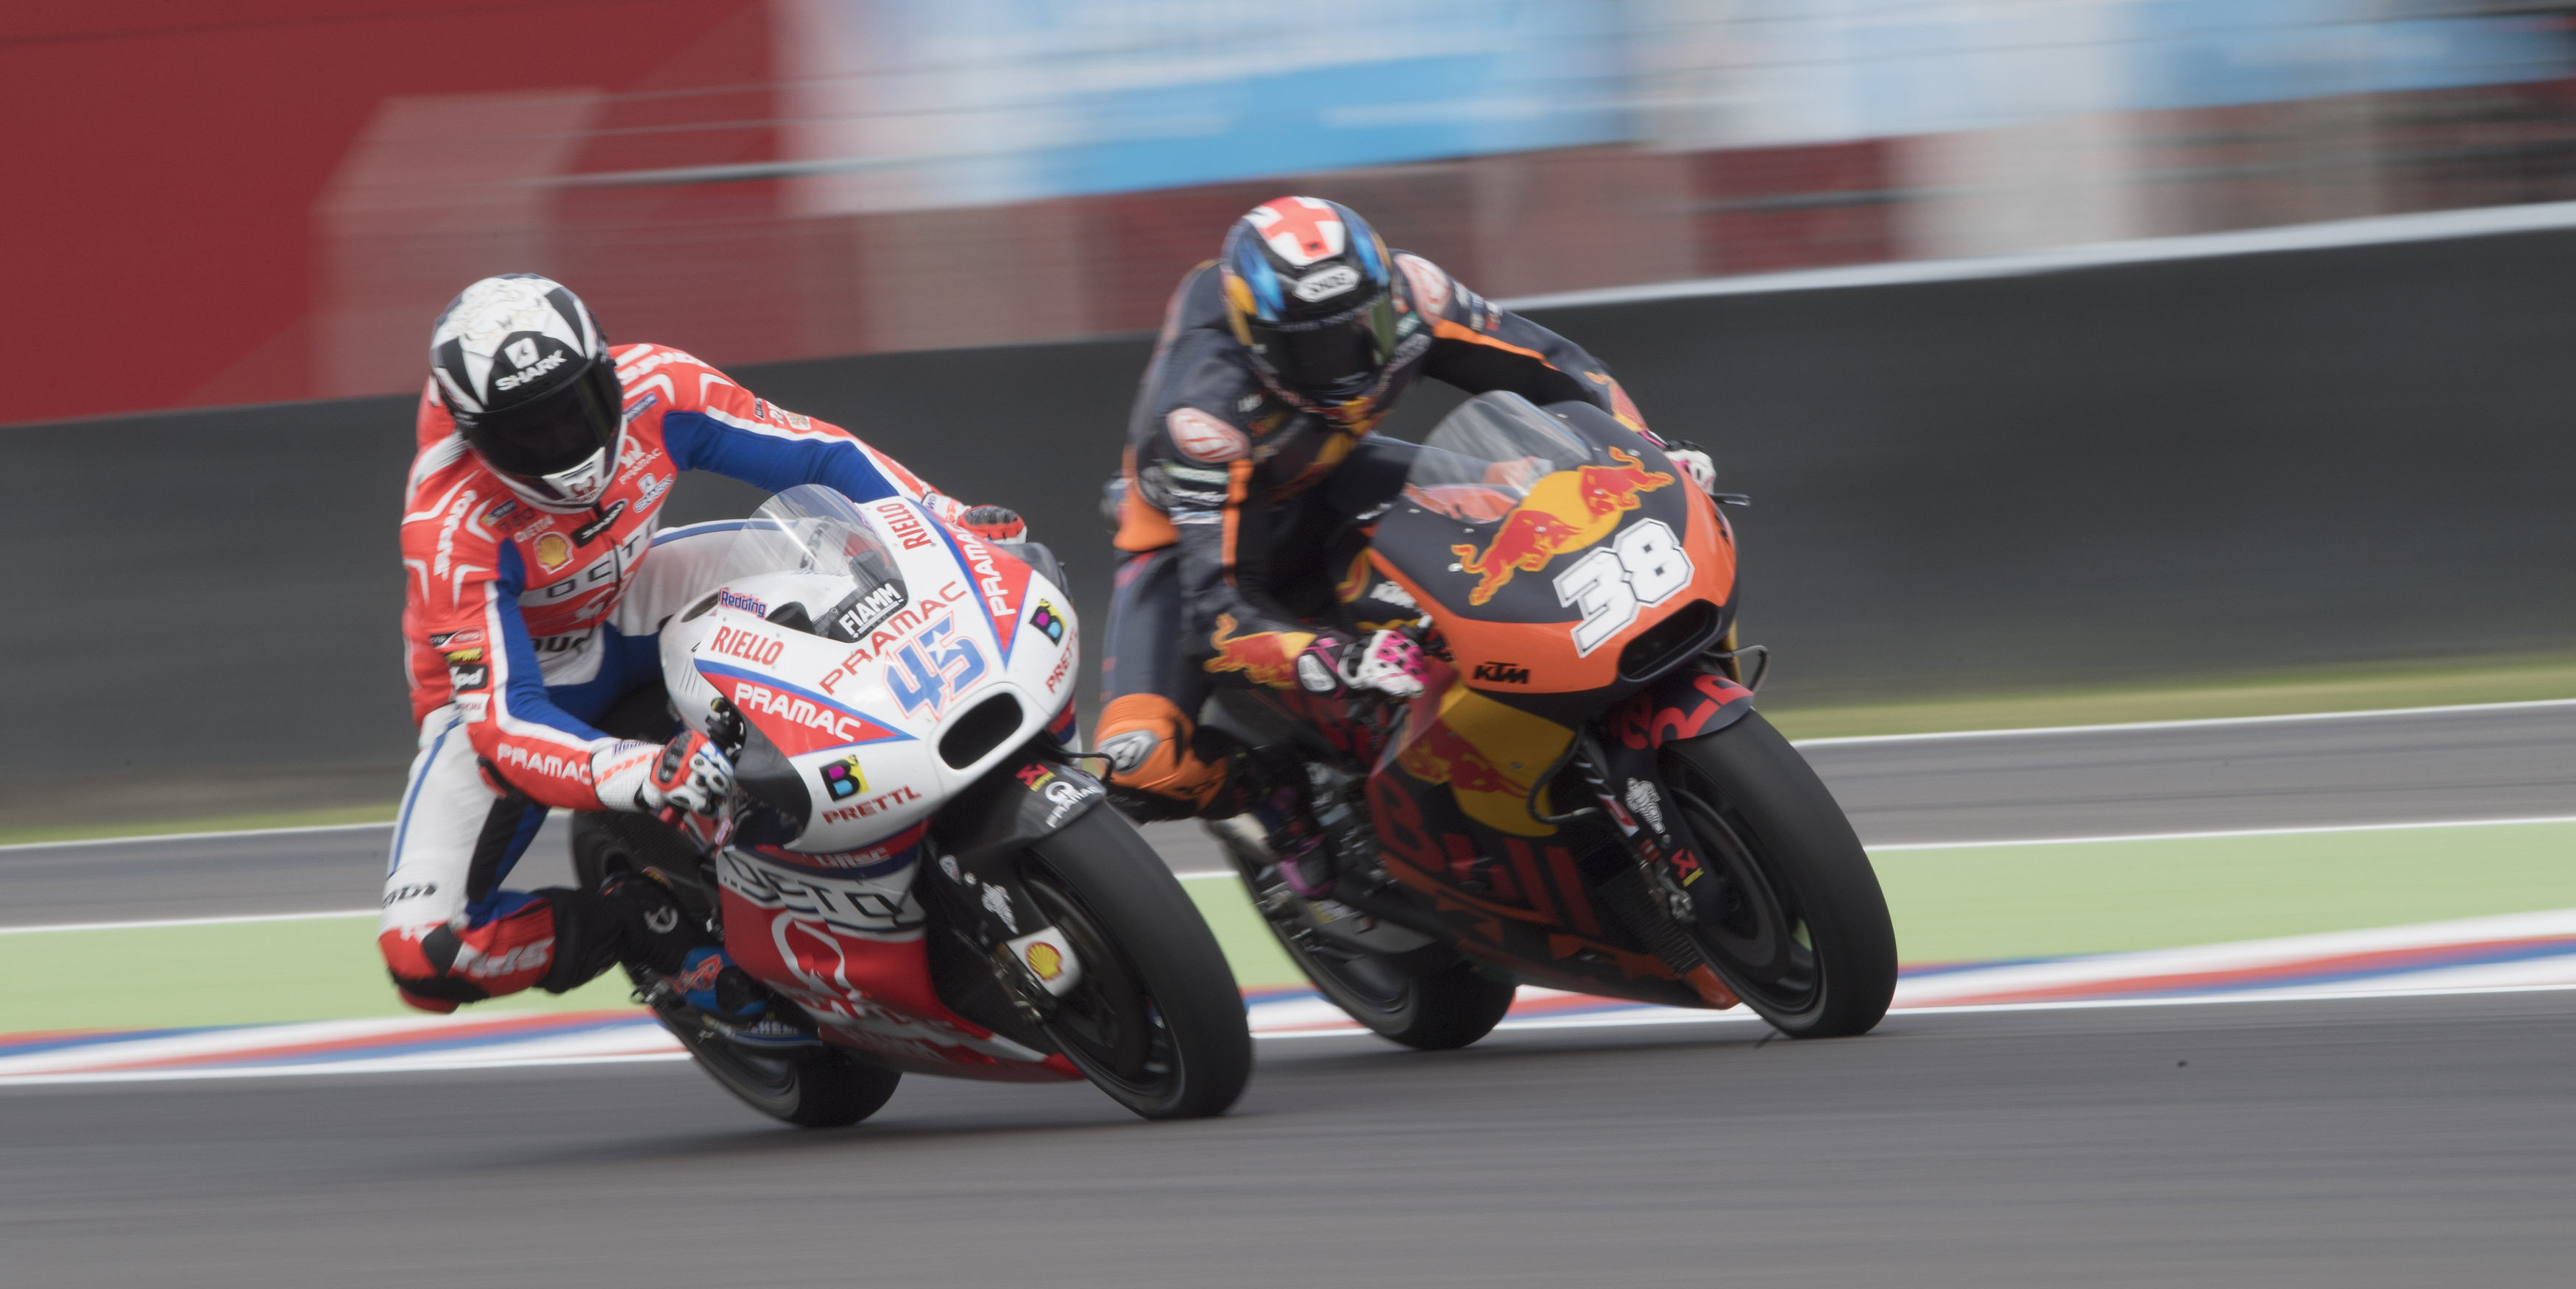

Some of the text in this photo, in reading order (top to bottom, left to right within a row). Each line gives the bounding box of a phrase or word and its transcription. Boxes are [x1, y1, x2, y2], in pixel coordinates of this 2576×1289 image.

[495, 349, 567, 391] SHARK
[877, 503, 933, 550] RIELLO
[945, 522, 1016, 617] PRAMAC
[1552, 517, 1695, 658] 38
[719, 589, 768, 619] Redding
[839, 583, 902, 636] FIAMM
[710, 625, 784, 667] RIELLO
[818, 580, 967, 695] PRAMAC
[884, 611, 989, 722] 45
[1473, 661, 1531, 685] KTM
[734, 681, 861, 742] PRAMAC
[497, 742, 592, 786] PRAMAC
[821, 785, 922, 825] PRETTL
[722, 851, 905, 917] OCTO
